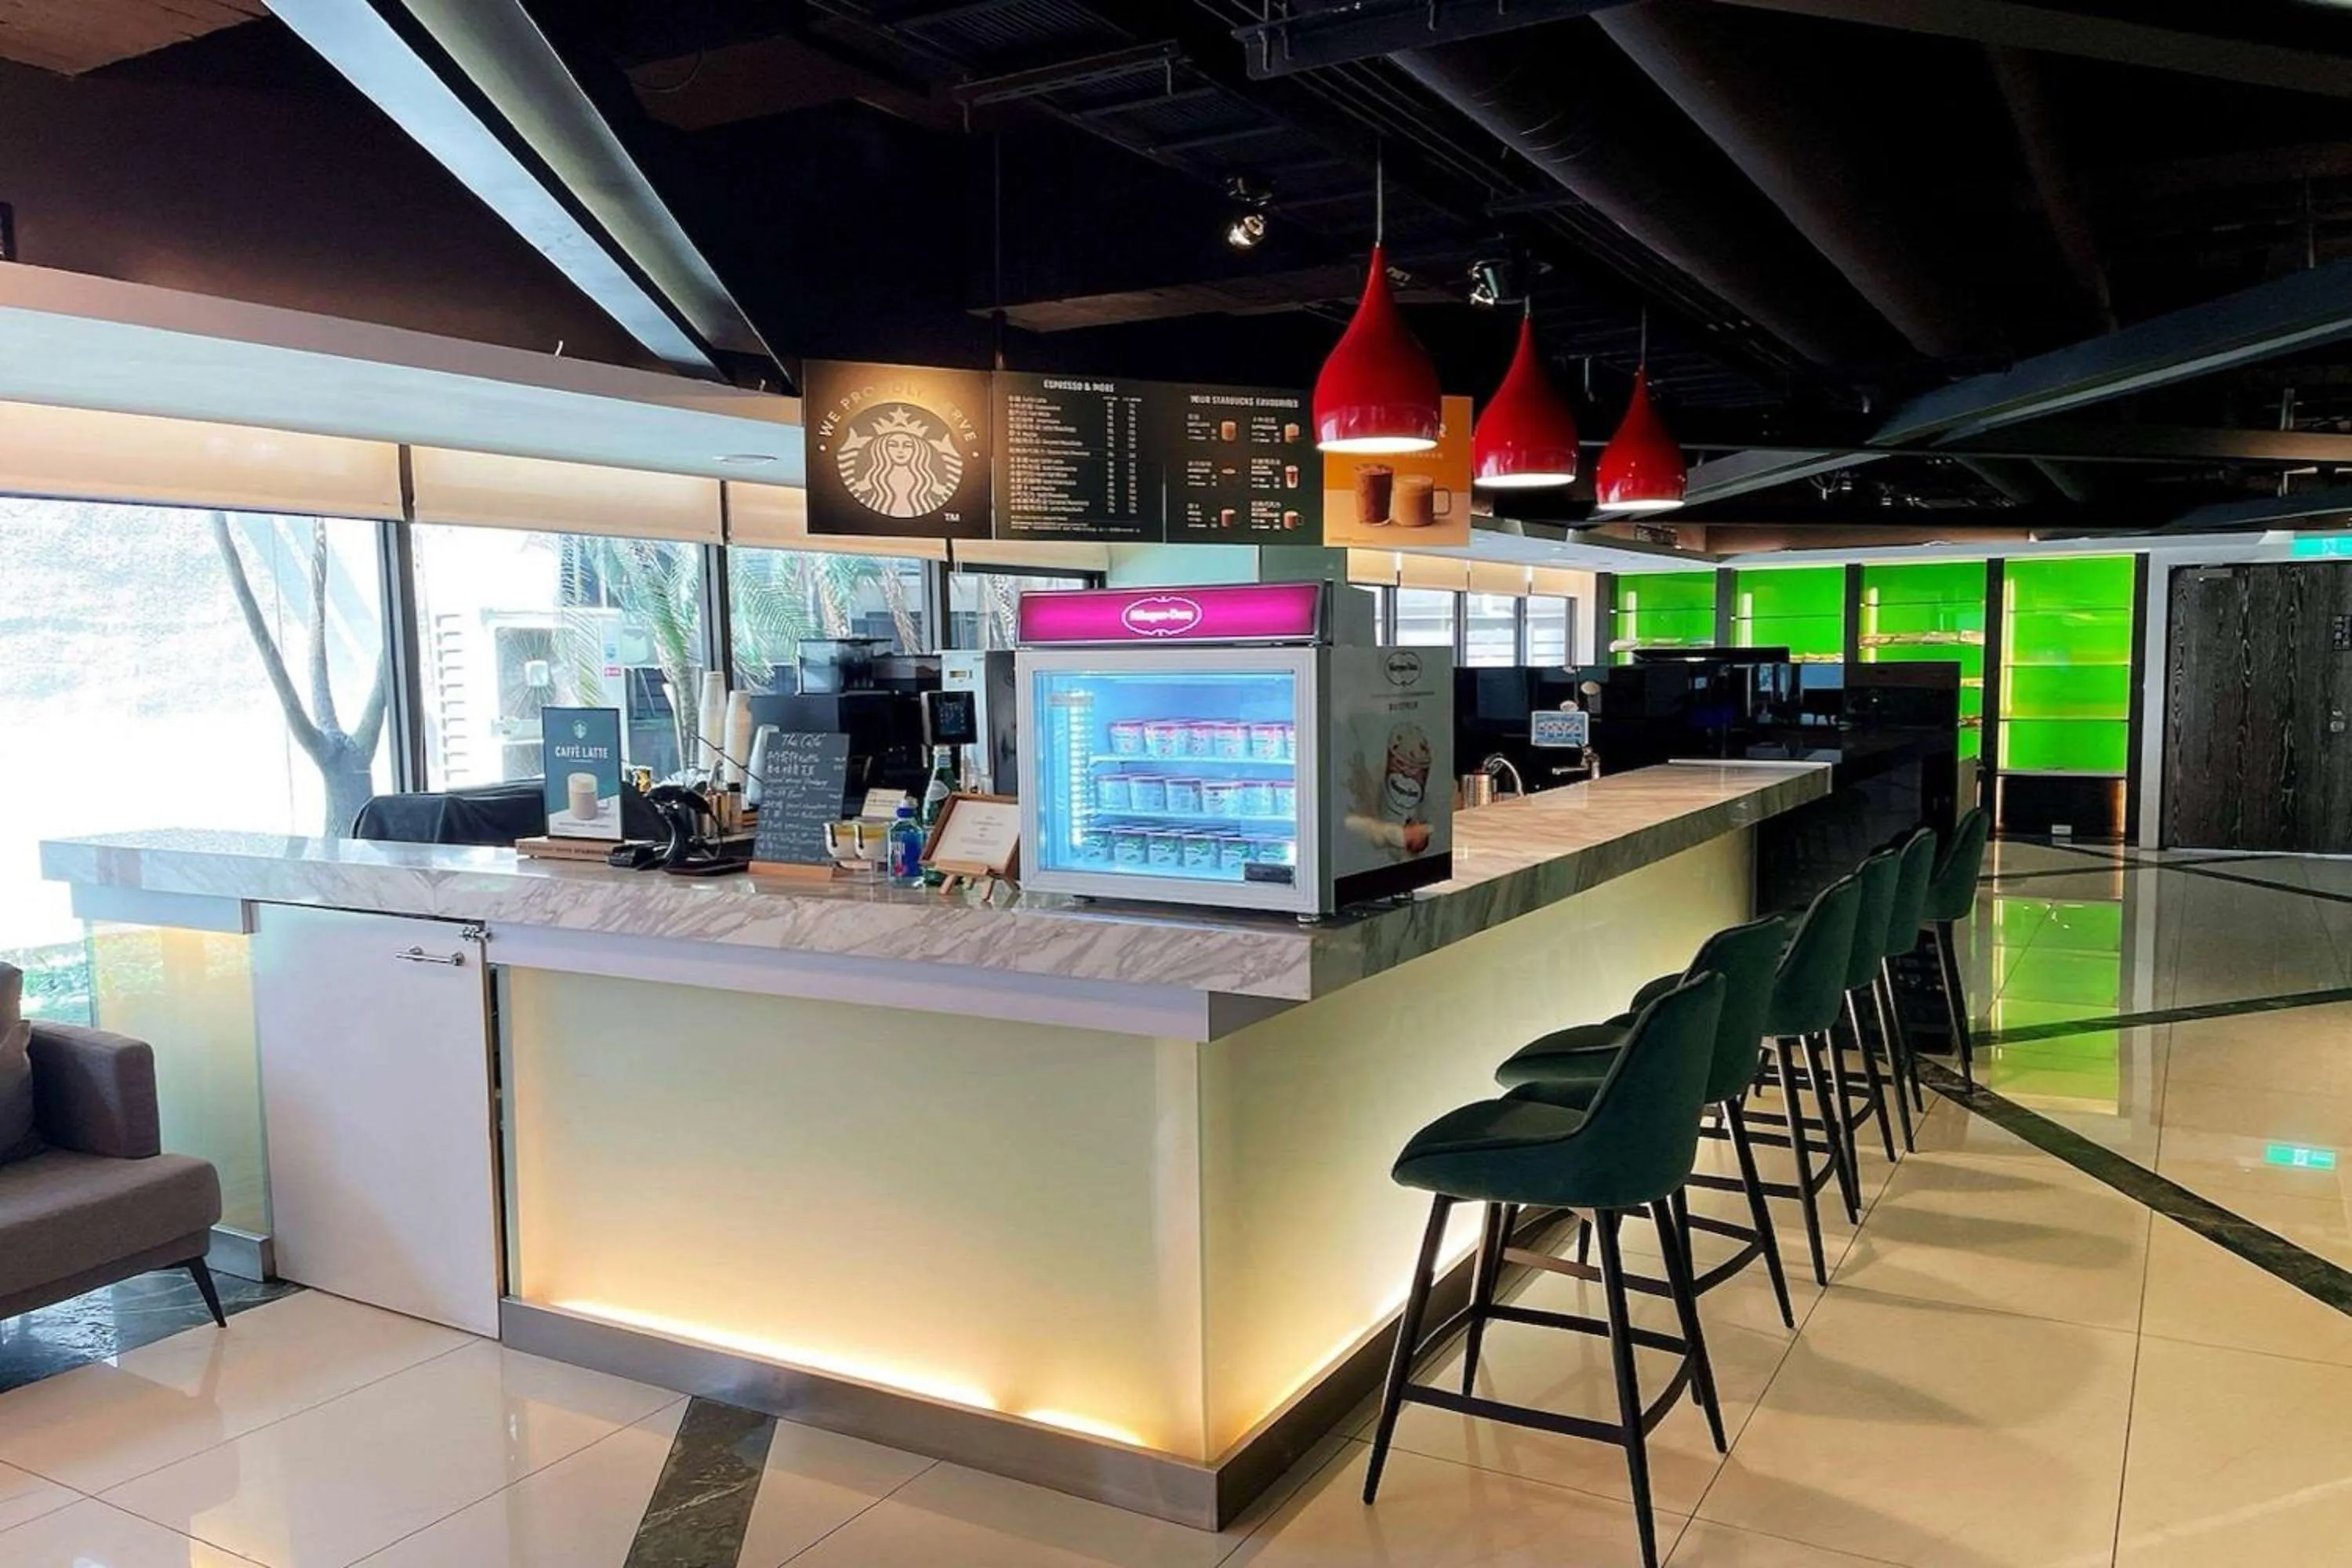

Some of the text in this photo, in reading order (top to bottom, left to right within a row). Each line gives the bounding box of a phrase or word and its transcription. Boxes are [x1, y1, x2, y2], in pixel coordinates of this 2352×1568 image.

[1212, 395, 1254, 406] STARBUCKS
[819, 411, 841, 437] WE
[944, 512, 960, 522] TM
[582, 746, 608, 760] LATTE
